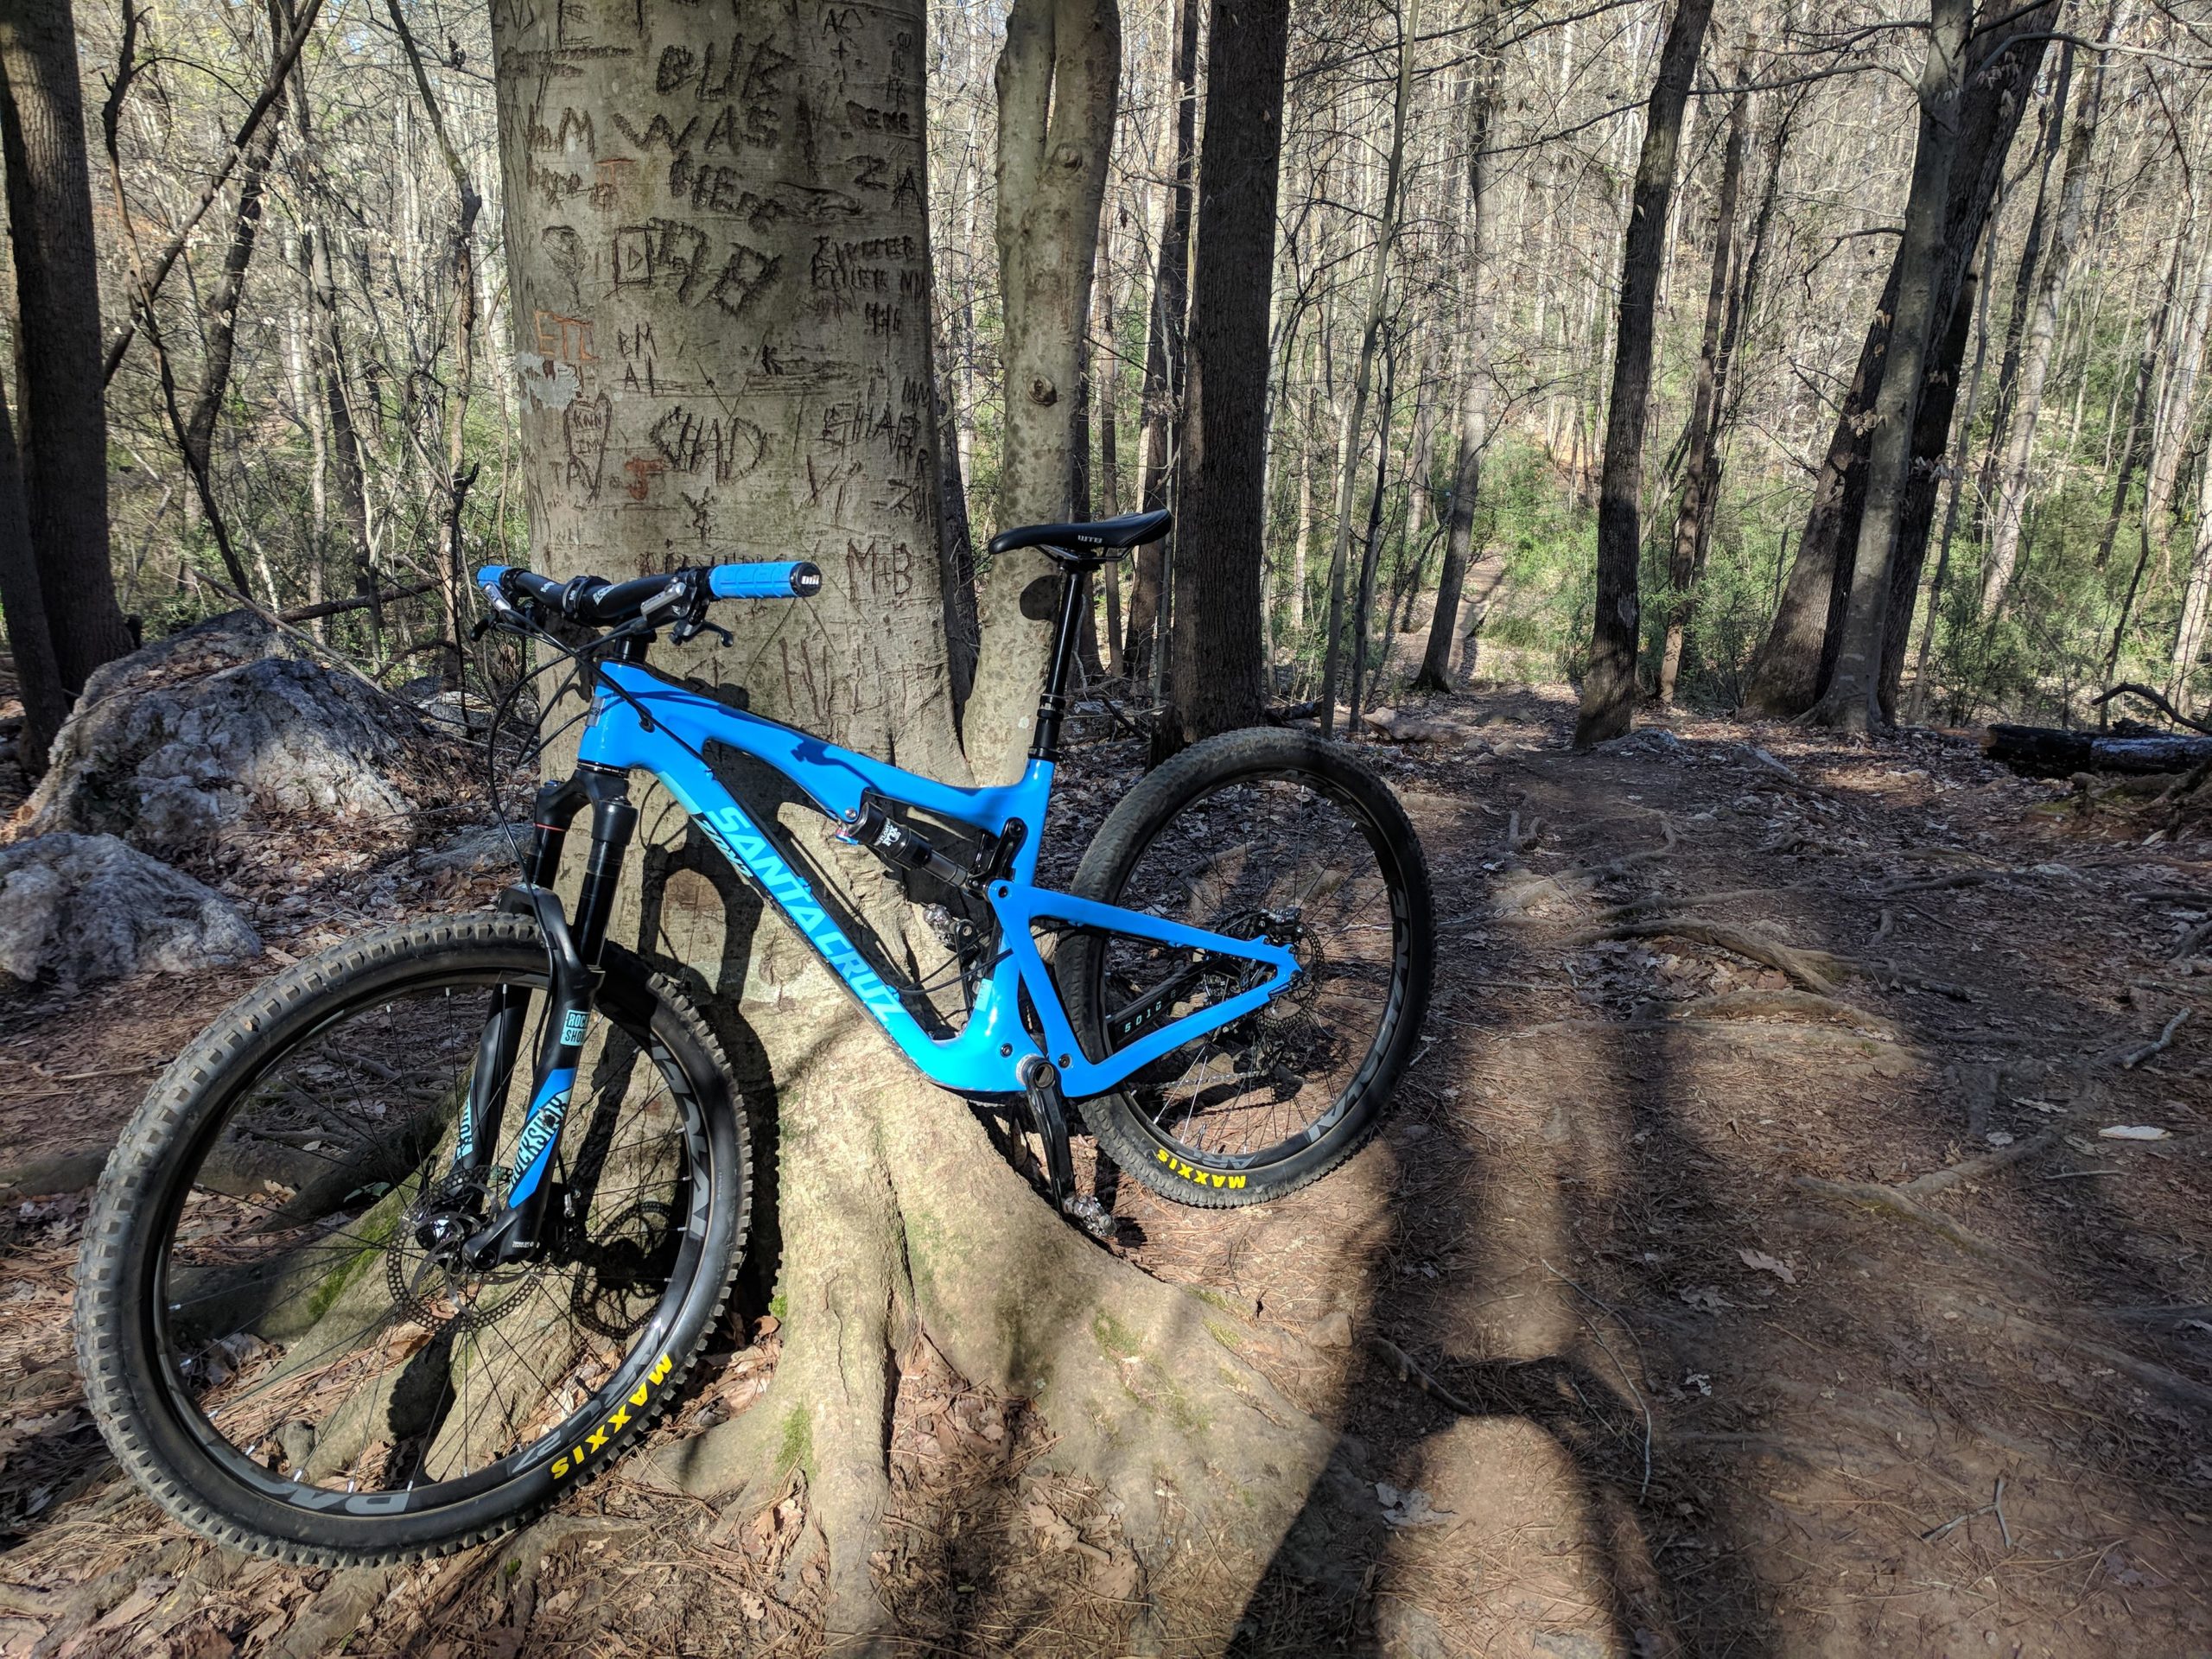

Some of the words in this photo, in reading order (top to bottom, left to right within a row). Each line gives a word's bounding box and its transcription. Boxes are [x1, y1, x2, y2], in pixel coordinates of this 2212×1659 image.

[650, 405, 768, 486] CHAD
[705, 805, 828, 931] SANTA
[815, 931, 908, 1023] CRUZ
[564, 1028, 587, 1043] SHO
[1156, 1147, 1247, 1189] MAXXIS
[550, 1352, 673, 1481] MAXXIS
